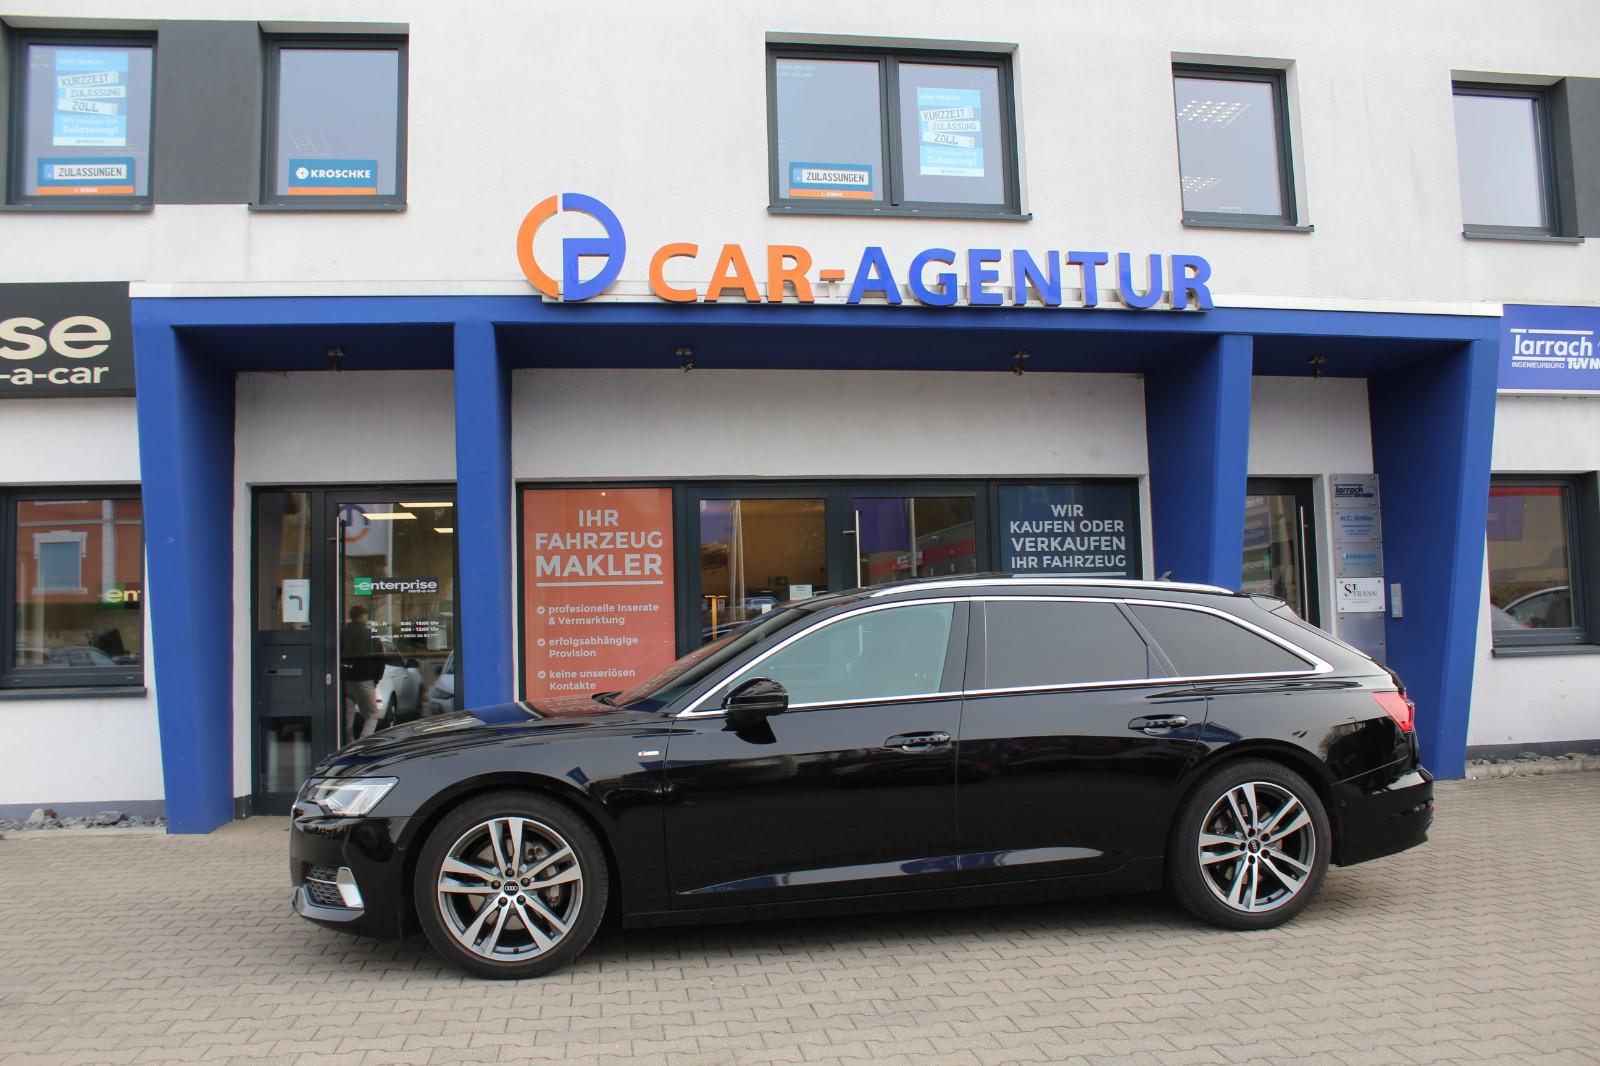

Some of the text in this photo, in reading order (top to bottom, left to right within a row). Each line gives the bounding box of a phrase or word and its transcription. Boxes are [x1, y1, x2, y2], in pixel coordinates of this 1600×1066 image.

[70, 88, 121, 97] ZULASSUNG
[72, 100, 98, 112] ZOLL
[923, 109, 965, 121] KURZZEIT
[932, 122, 977, 131] ZULASSUNG
[934, 133, 959, 145] ZOLL
[58, 167, 122, 177] ZULASSUNGEN
[310, 169, 371, 179] KROSCHKE
[806, 171, 865, 183] ZULASSUNGEN
[648, 242, 1215, 311] CAR-AGENTUR
[1050, 504, 1084, 517] WIR
[578, 509, 619, 528] IHR
[1010, 519, 1125, 534] KAUFEN ODER
[535, 531, 663, 550] FAHRZEUG
[1011, 536, 1126, 552] VERKAUFEN
[535, 553, 664, 578] MAKLER
[1011, 554, 1126, 569] IHR FAHRZEUG
[357, 579, 437, 592] enterprise
[104, 588, 141, 603] en
[548, 603, 660, 616] profesionelle Inserate
[548, 616, 625, 626] & Vermarktung
[548, 636, 639, 648] erfolgsabhängige
[549, 649, 597, 658] Provision
[549, 668, 636, 679] keine unseriösen
[549, 681, 597, 691] Kontakte
